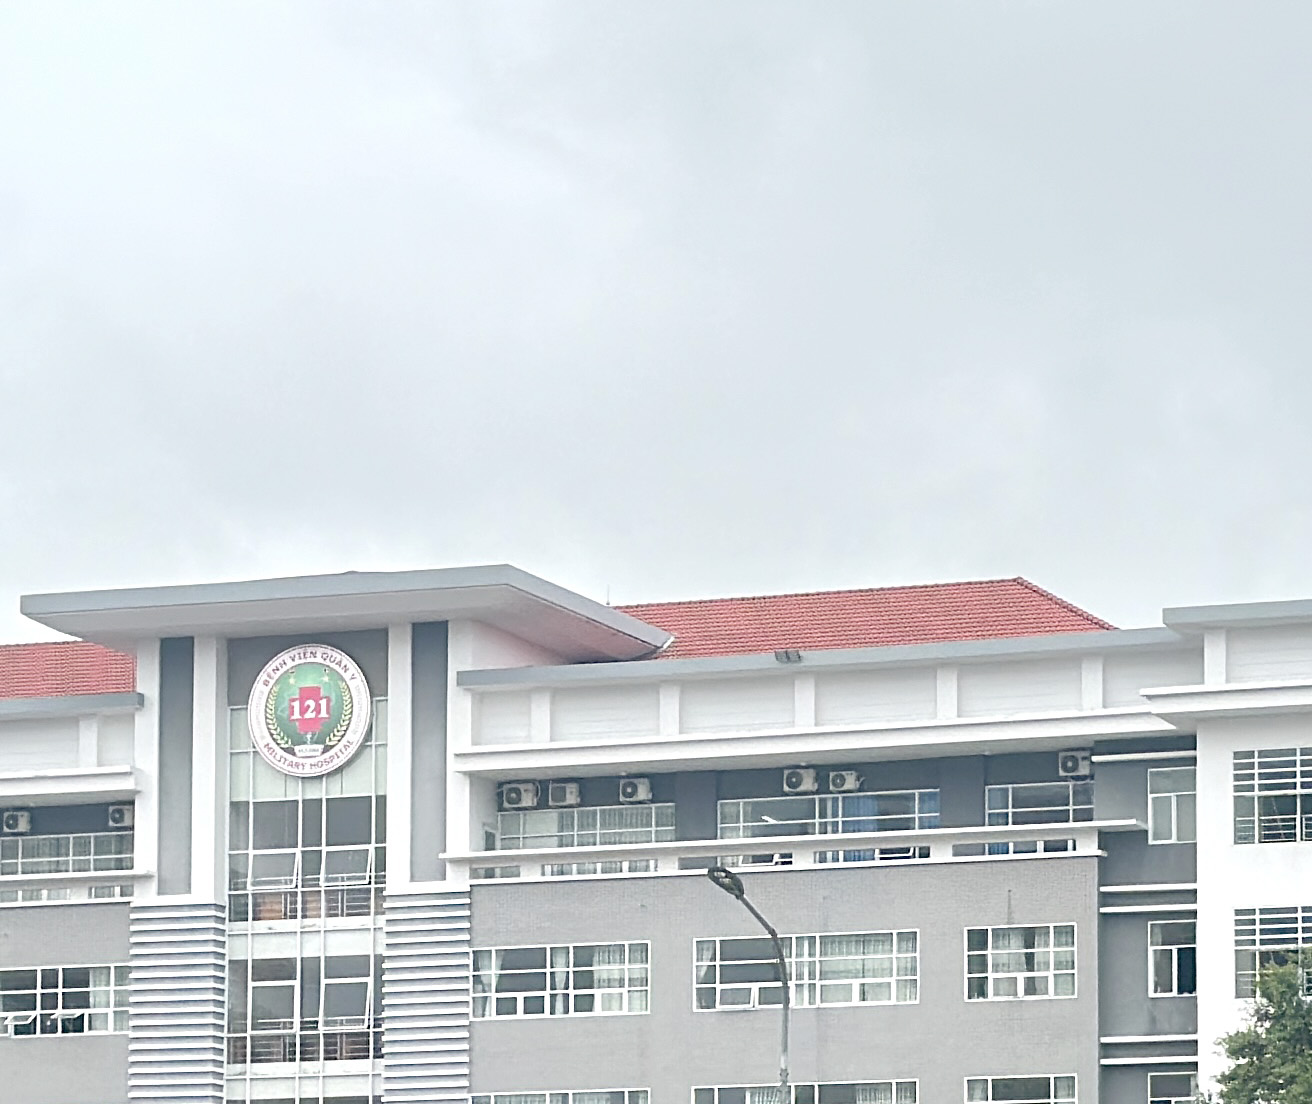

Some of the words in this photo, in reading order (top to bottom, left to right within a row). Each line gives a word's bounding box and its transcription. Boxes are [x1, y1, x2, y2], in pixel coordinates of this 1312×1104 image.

[349, 672, 358, 681] Y
[290, 699, 329, 720] 121
[309, 740, 354, 769] HOSPITAL
